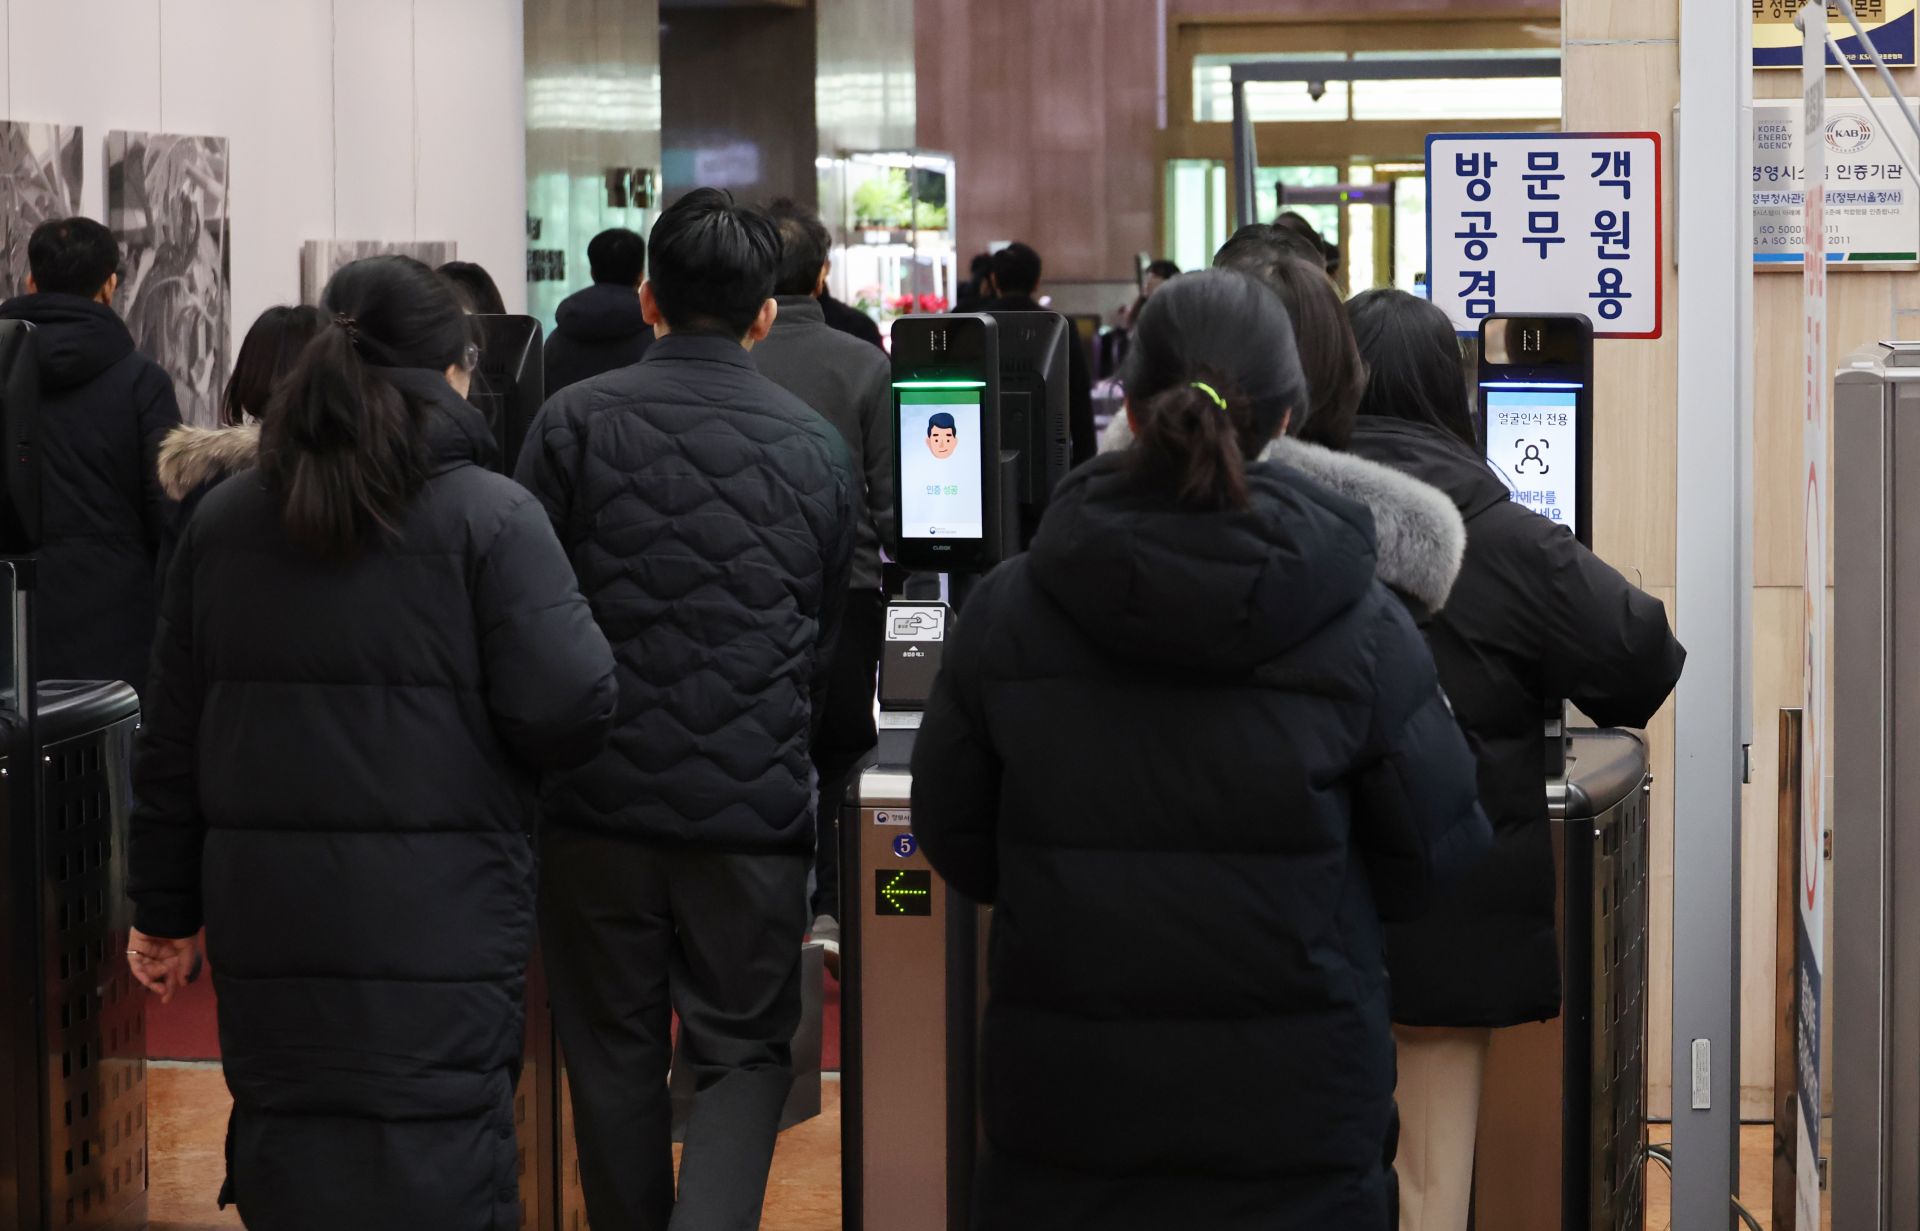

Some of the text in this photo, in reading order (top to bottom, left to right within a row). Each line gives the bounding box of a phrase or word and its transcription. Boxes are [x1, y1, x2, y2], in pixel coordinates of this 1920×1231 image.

[1758, 125, 1787, 133] KOREA
[1835, 129, 1859, 138] KAB
[1753, 164, 1903, 182] 경영시스 인증기관
[1759, 225, 1775, 234] ISO
[1761, 237, 1769, 245] A
[1771, 237, 1787, 245] ISO
[1828, 236, 1850, 244] 2011
[1498, 411, 1569, 427] 얼굴인식 전용
[926, 485, 958, 495] 인증 성공
[1532, 508, 1562, 520] 세요
[901, 838, 910, 853] 5
